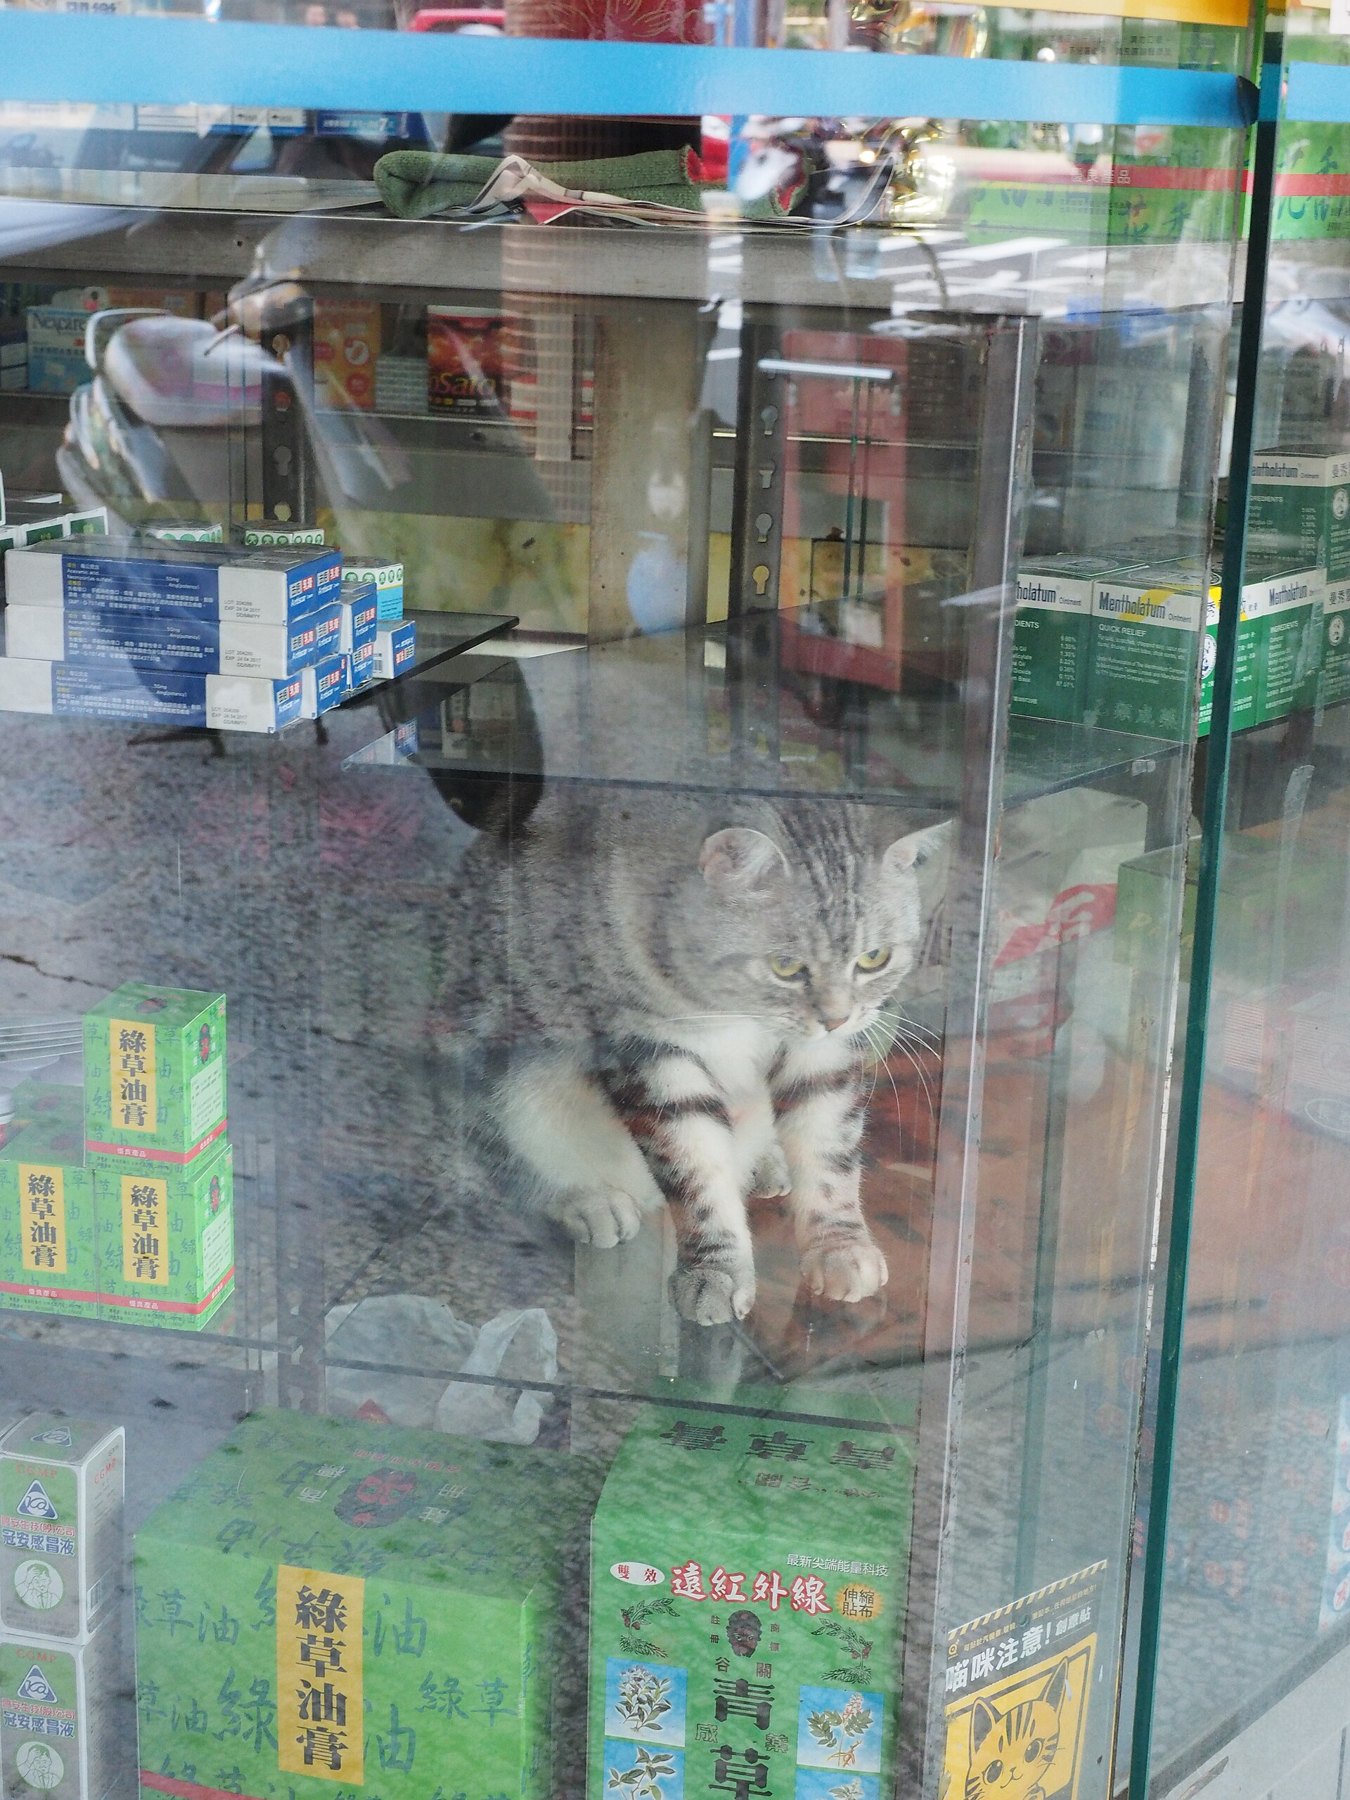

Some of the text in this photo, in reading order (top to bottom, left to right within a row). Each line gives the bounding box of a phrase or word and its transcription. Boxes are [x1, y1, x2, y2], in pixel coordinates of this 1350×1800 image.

[1016, 581, 1057, 603] holatum
[1099, 591, 1166, 619] Mentholatum
[1269, 582, 1308, 606] Mentholatum
[1099, 623, 1147, 637] QUICK RELIEF
[120, 1029, 148, 1127] 綠草油膏
[28, 1174, 57, 1268] 綠草油膏
[130, 1184, 160, 1280] 綠草油膏
[2, 1529, 75, 1556] 冠安感冒液
[617, 1564, 658, 1583] 雙效
[786, 1553, 889, 1577] 最新尖端能量科技
[671, 1560, 832, 1615] 遠紅外線
[843, 1588, 875, 1602] 伸縮
[842, 1602, 874, 1617] 貼布
[945, 1622, 1052, 1692] 喵咪注意!
[295, 1584, 349, 1771] 綠草油膏
[3, 1710, 76, 1739] 冠安感冒液
